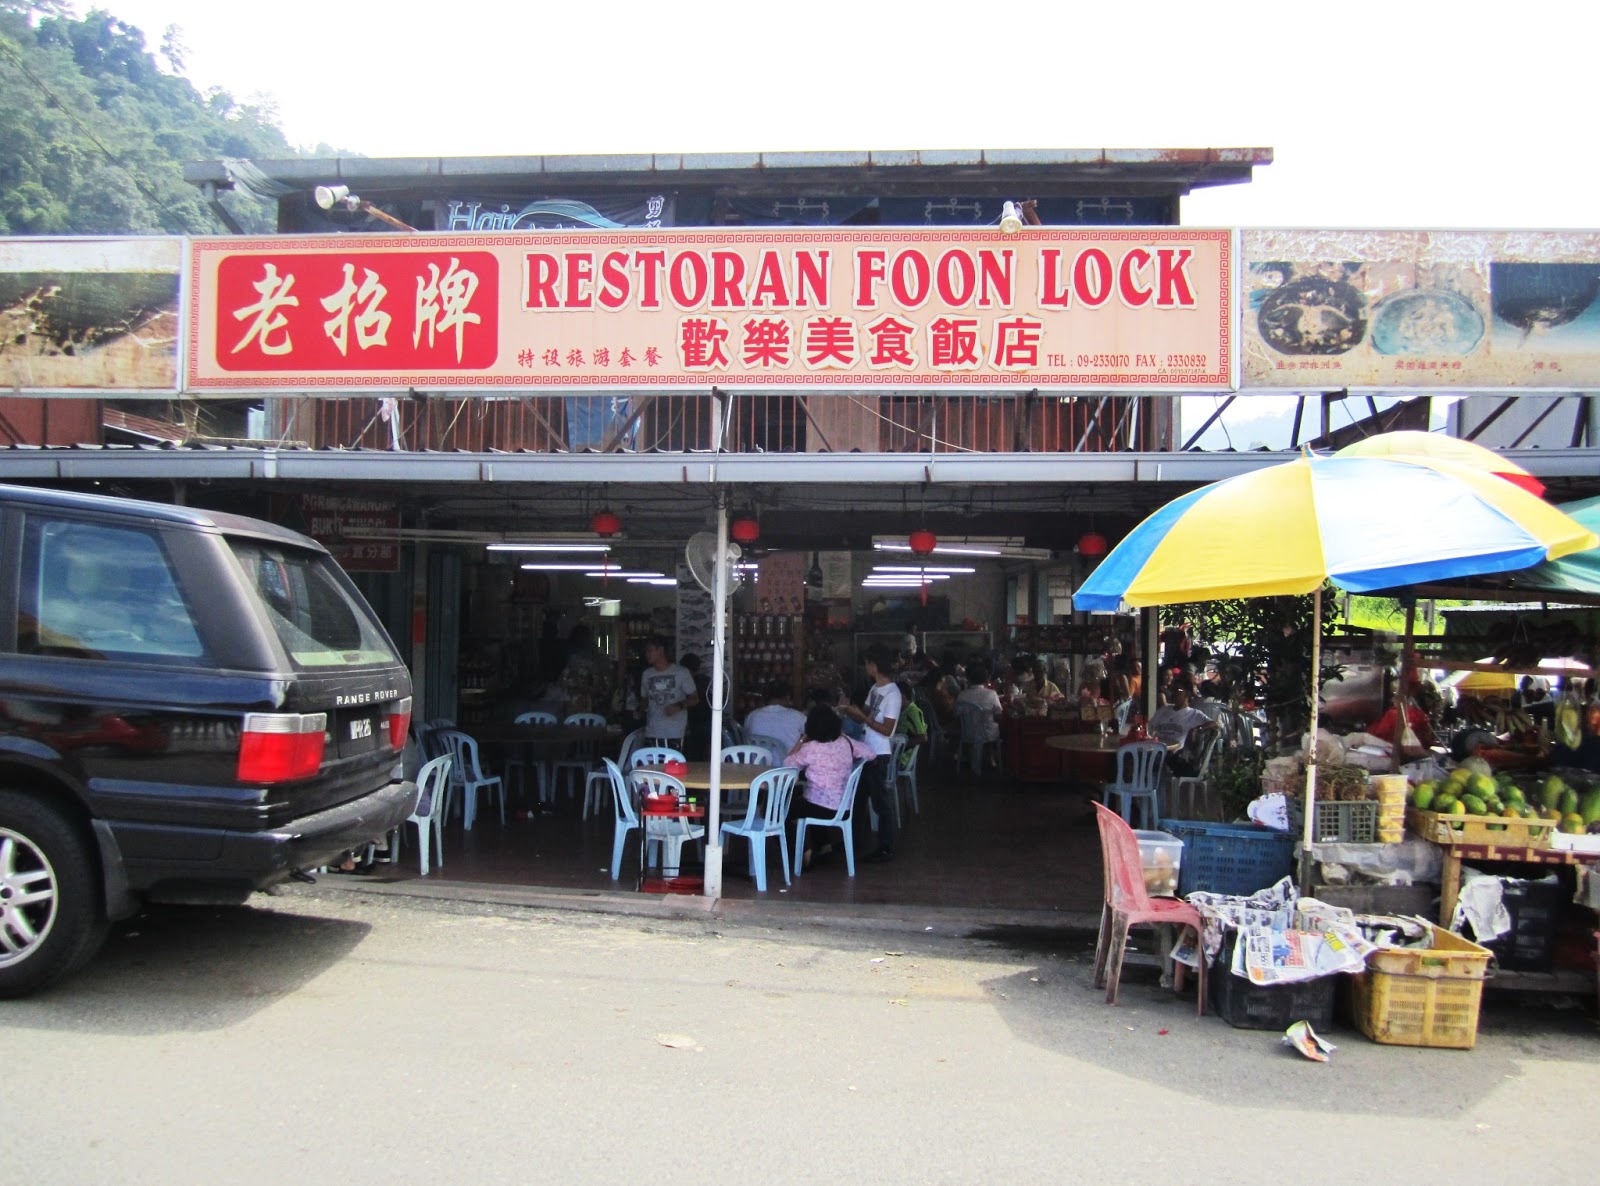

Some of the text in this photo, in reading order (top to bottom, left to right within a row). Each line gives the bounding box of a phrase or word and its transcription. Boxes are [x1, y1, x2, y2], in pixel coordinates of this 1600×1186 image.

[526, 248, 1195, 308] RESTORAN FOON LOCK
[231, 257, 481, 364] 老招牌
[517, 347, 662, 368] 特设旅游套餐
[681, 316, 1041, 369] 歡樂美食飯店
[1047, 354, 1066, 367] TEL
[1077, 354, 1130, 367] 09-2330170
[1136, 354, 1156, 367] FAX
[1167, 354, 1207, 367] 2330832
[336, 689, 398, 706] RANGE ROVER
